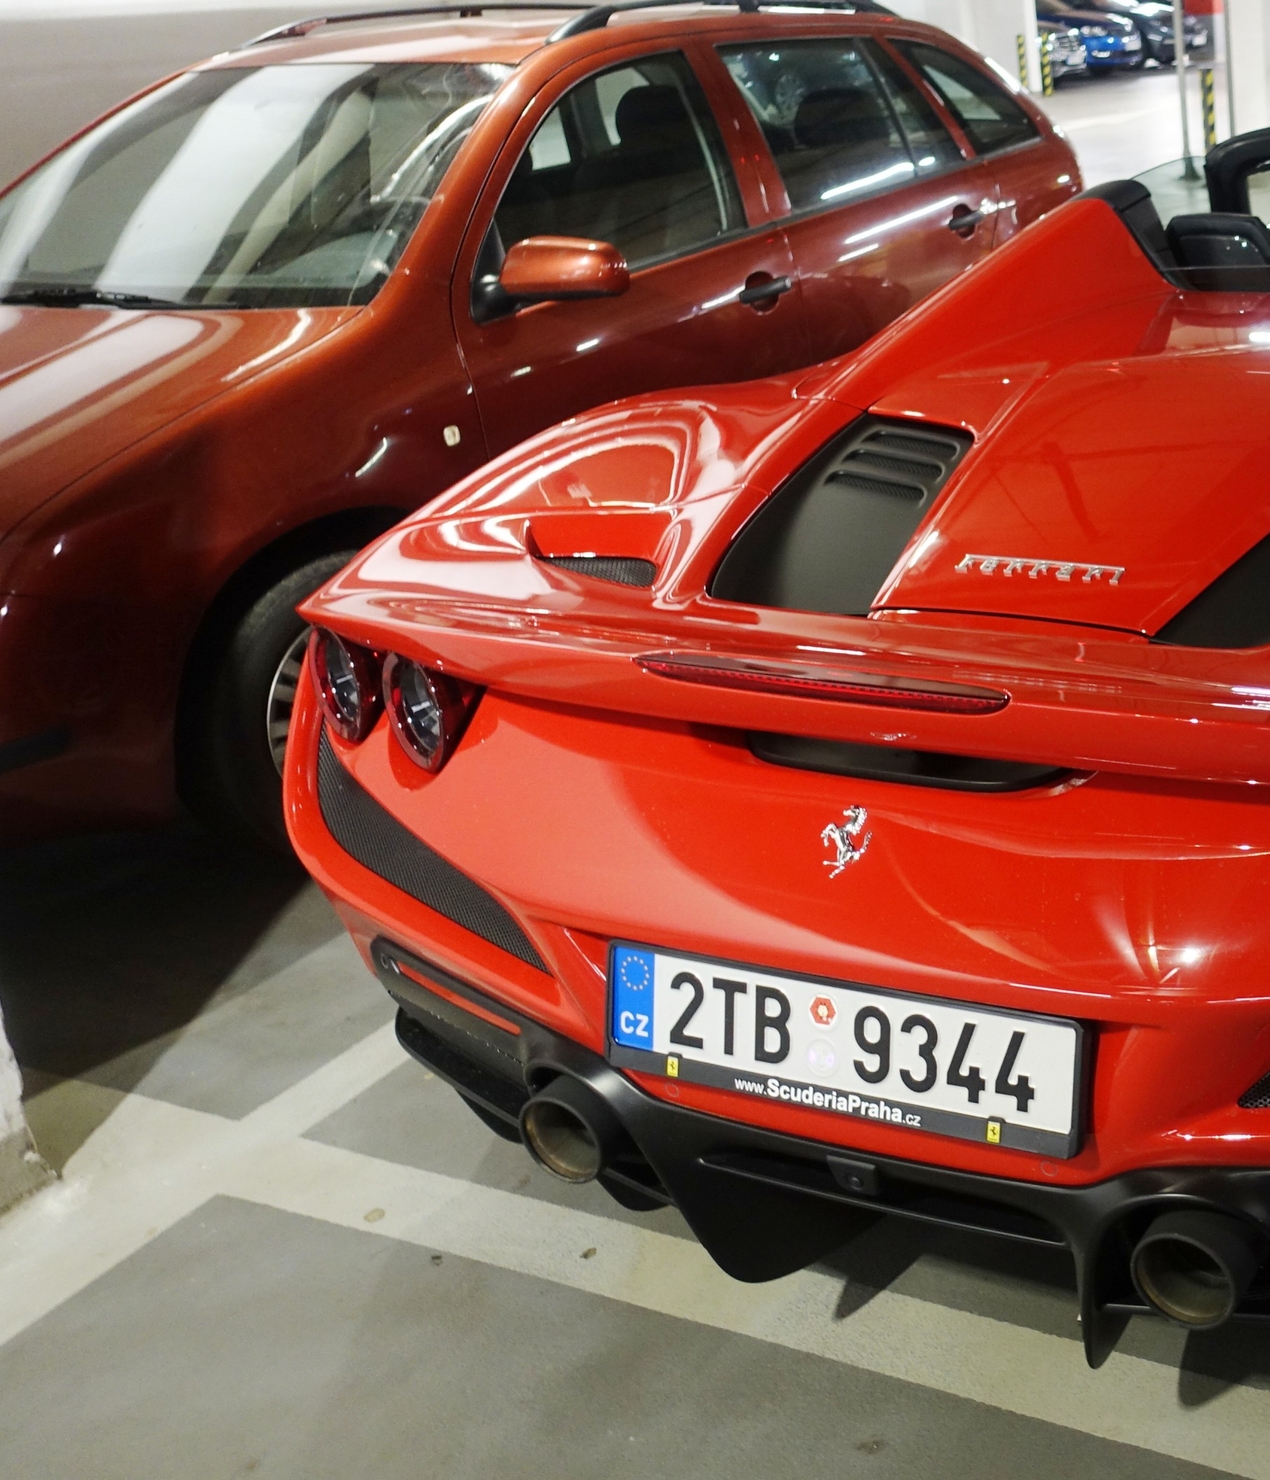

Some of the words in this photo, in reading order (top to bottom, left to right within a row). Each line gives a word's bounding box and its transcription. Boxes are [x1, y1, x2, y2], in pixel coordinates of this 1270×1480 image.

[620, 1010, 649, 1038] CZ
[669, 971, 791, 1064] 2TB
[853, 1005, 1035, 1113] 9344
[734, 1078, 922, 1127] www.ScuderiaPraha.cz
